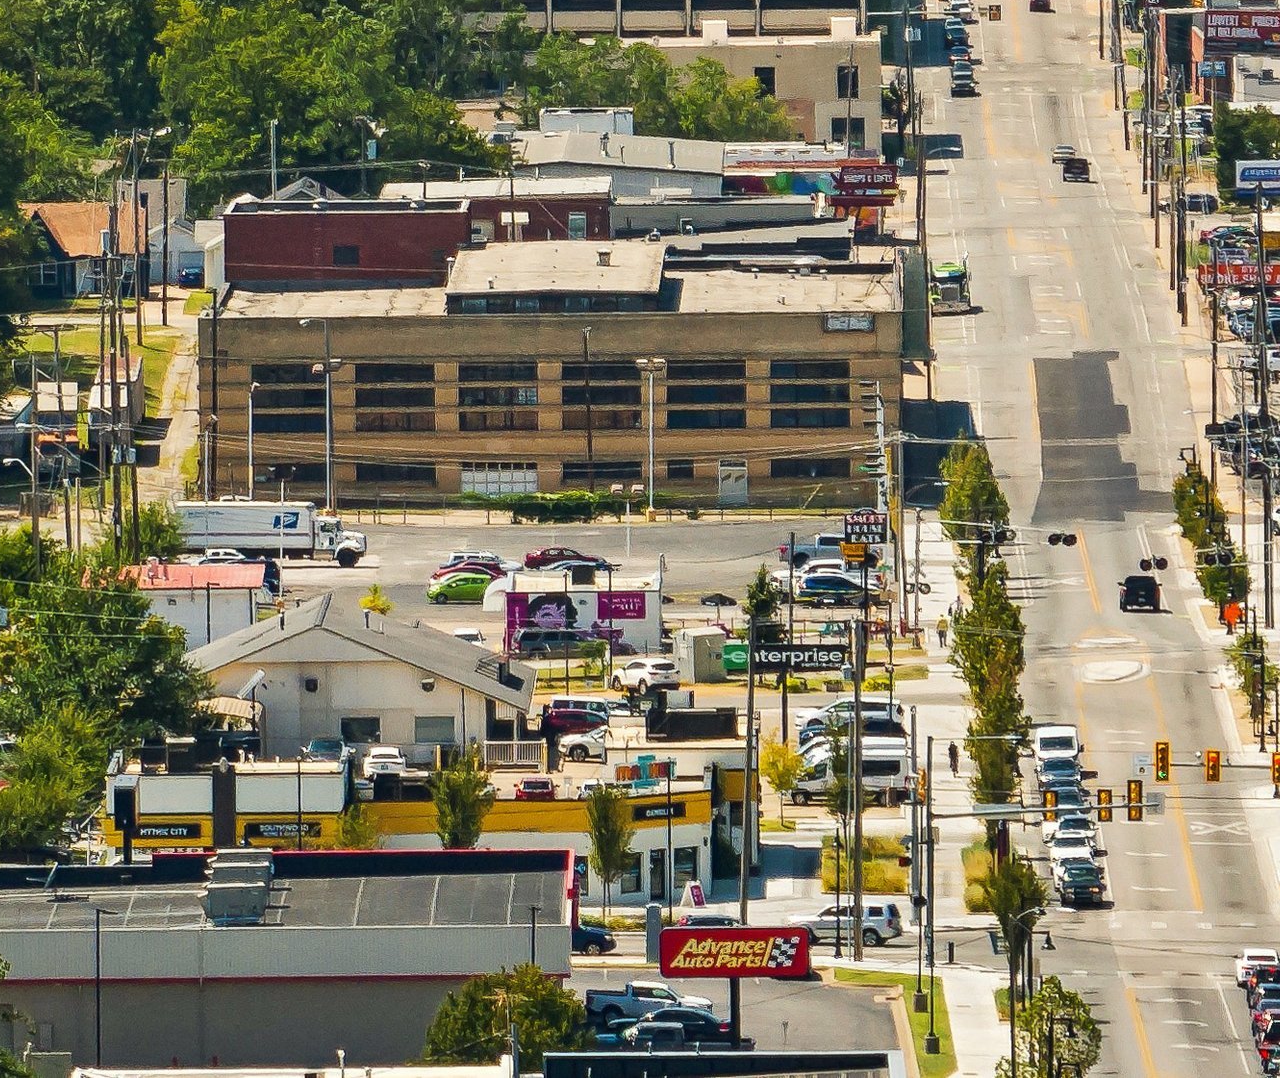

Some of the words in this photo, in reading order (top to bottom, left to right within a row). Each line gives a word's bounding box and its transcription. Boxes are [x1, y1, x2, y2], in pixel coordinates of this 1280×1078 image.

[680, 938, 767, 956] Advance
[671, 953, 714, 969] Auto
[716, 953, 764, 968] Parts
